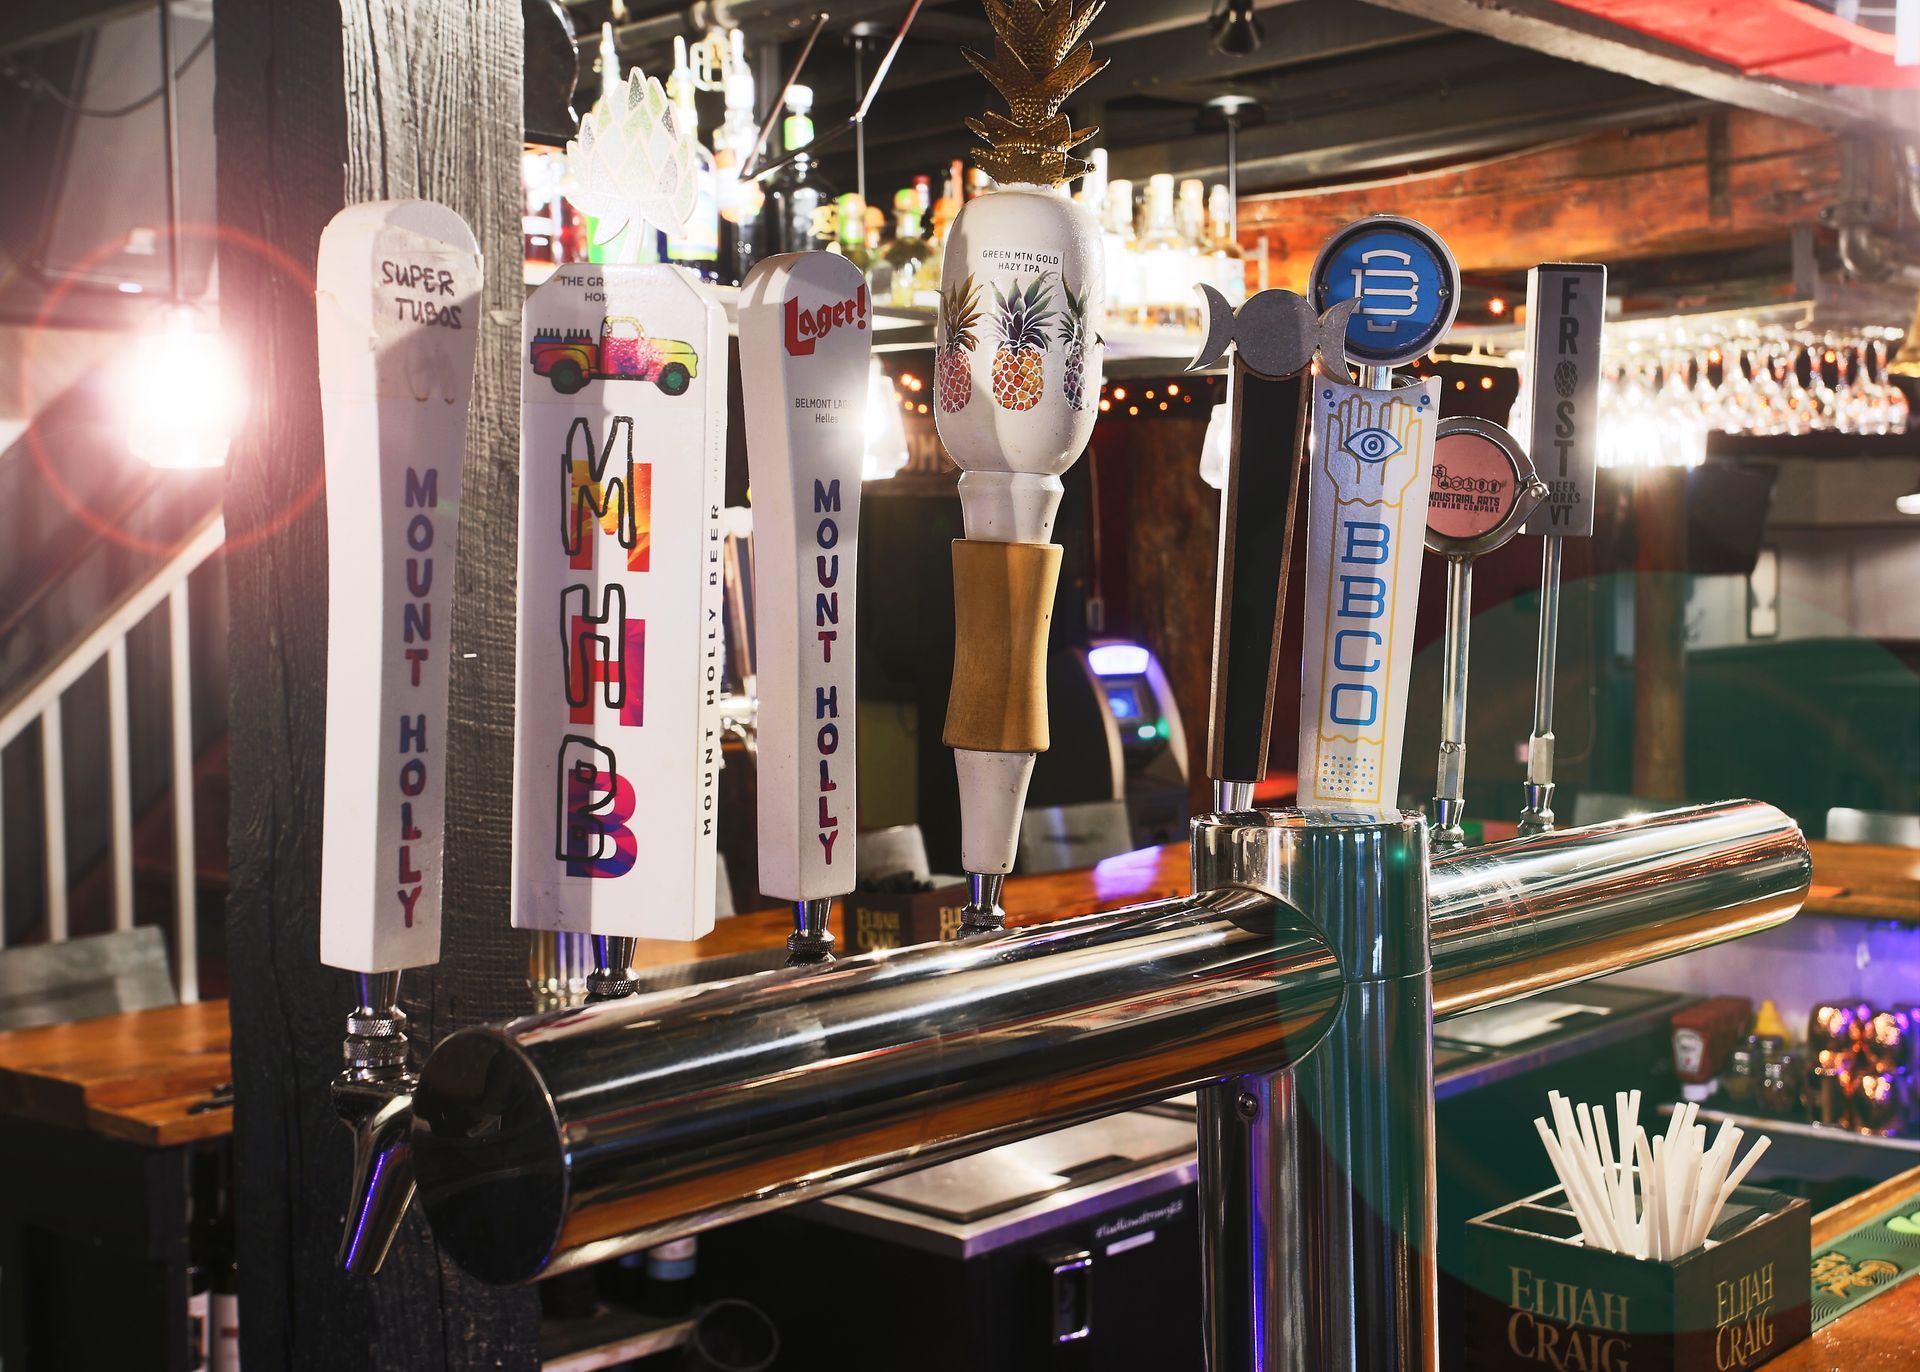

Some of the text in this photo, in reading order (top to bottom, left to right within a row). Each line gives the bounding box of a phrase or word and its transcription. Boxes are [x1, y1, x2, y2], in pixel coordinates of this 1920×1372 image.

[382, 260, 455, 296] SUPER
[560, 276, 584, 287] THE
[982, 249, 1059, 265] GREEN MTN GOLD
[998, 262, 1041, 273] HAZY IPA
[395, 297, 462, 330] TUBOS
[784, 283, 866, 356] Lager!
[795, 398, 831, 409] BELMONT
[815, 413, 839, 424] Helles
[1429, 491, 1500, 507] NDUSTRIAL ARTS
[1550, 505, 1573, 526] VT
[709, 504, 719, 587] BEER
[1330, 521, 1390, 727] BBCO
[706, 608, 717, 706] HOLLY
[813, 478, 842, 866] MOUNT HOLLY
[398, 467, 438, 929] MOUNT HOLLY
[703, 728, 714, 837] MOUNT
[1508, 1265, 1631, 1334] ELIJAH
[1716, 1262, 1775, 1328] ELIJAH
[1507, 1311, 1630, 1372] CRAIG
[1716, 1305, 1776, 1371] CRAIG
